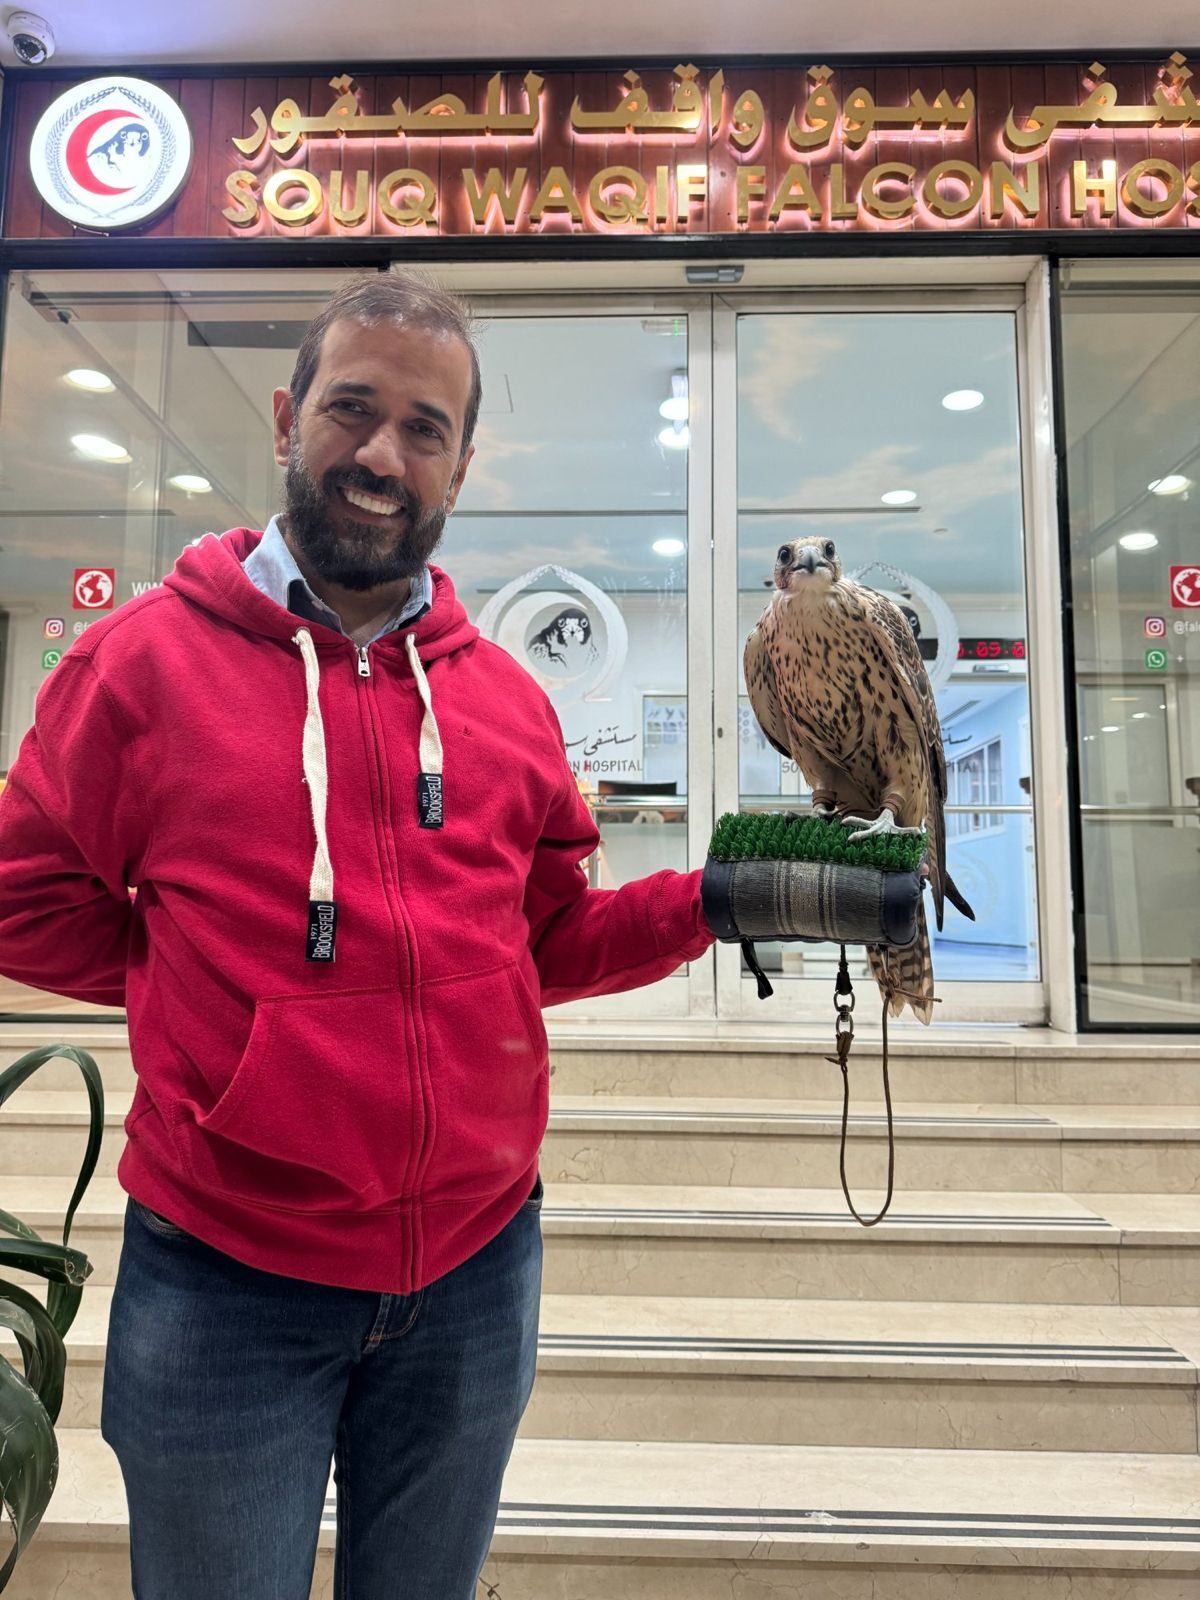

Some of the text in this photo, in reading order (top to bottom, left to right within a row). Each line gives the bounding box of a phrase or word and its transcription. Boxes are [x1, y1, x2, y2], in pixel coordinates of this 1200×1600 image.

[231, 70, 545, 155] للصقور
[569, 63, 765, 147] واقف
[787, 64, 975, 147] سوق
[222, 168, 438, 227] SOUQ
[462, 164, 708, 224] WAQIF
[735, 159, 1041, 221] FALCON
[583, 759, 644, 772] HOSPITAL
[421, 792, 429, 807] 1971
[425, 775, 443, 824] BROOKSFIELD
[310, 923, 318, 941] 1971
[312, 904, 335, 959] BROOKSFIELD
